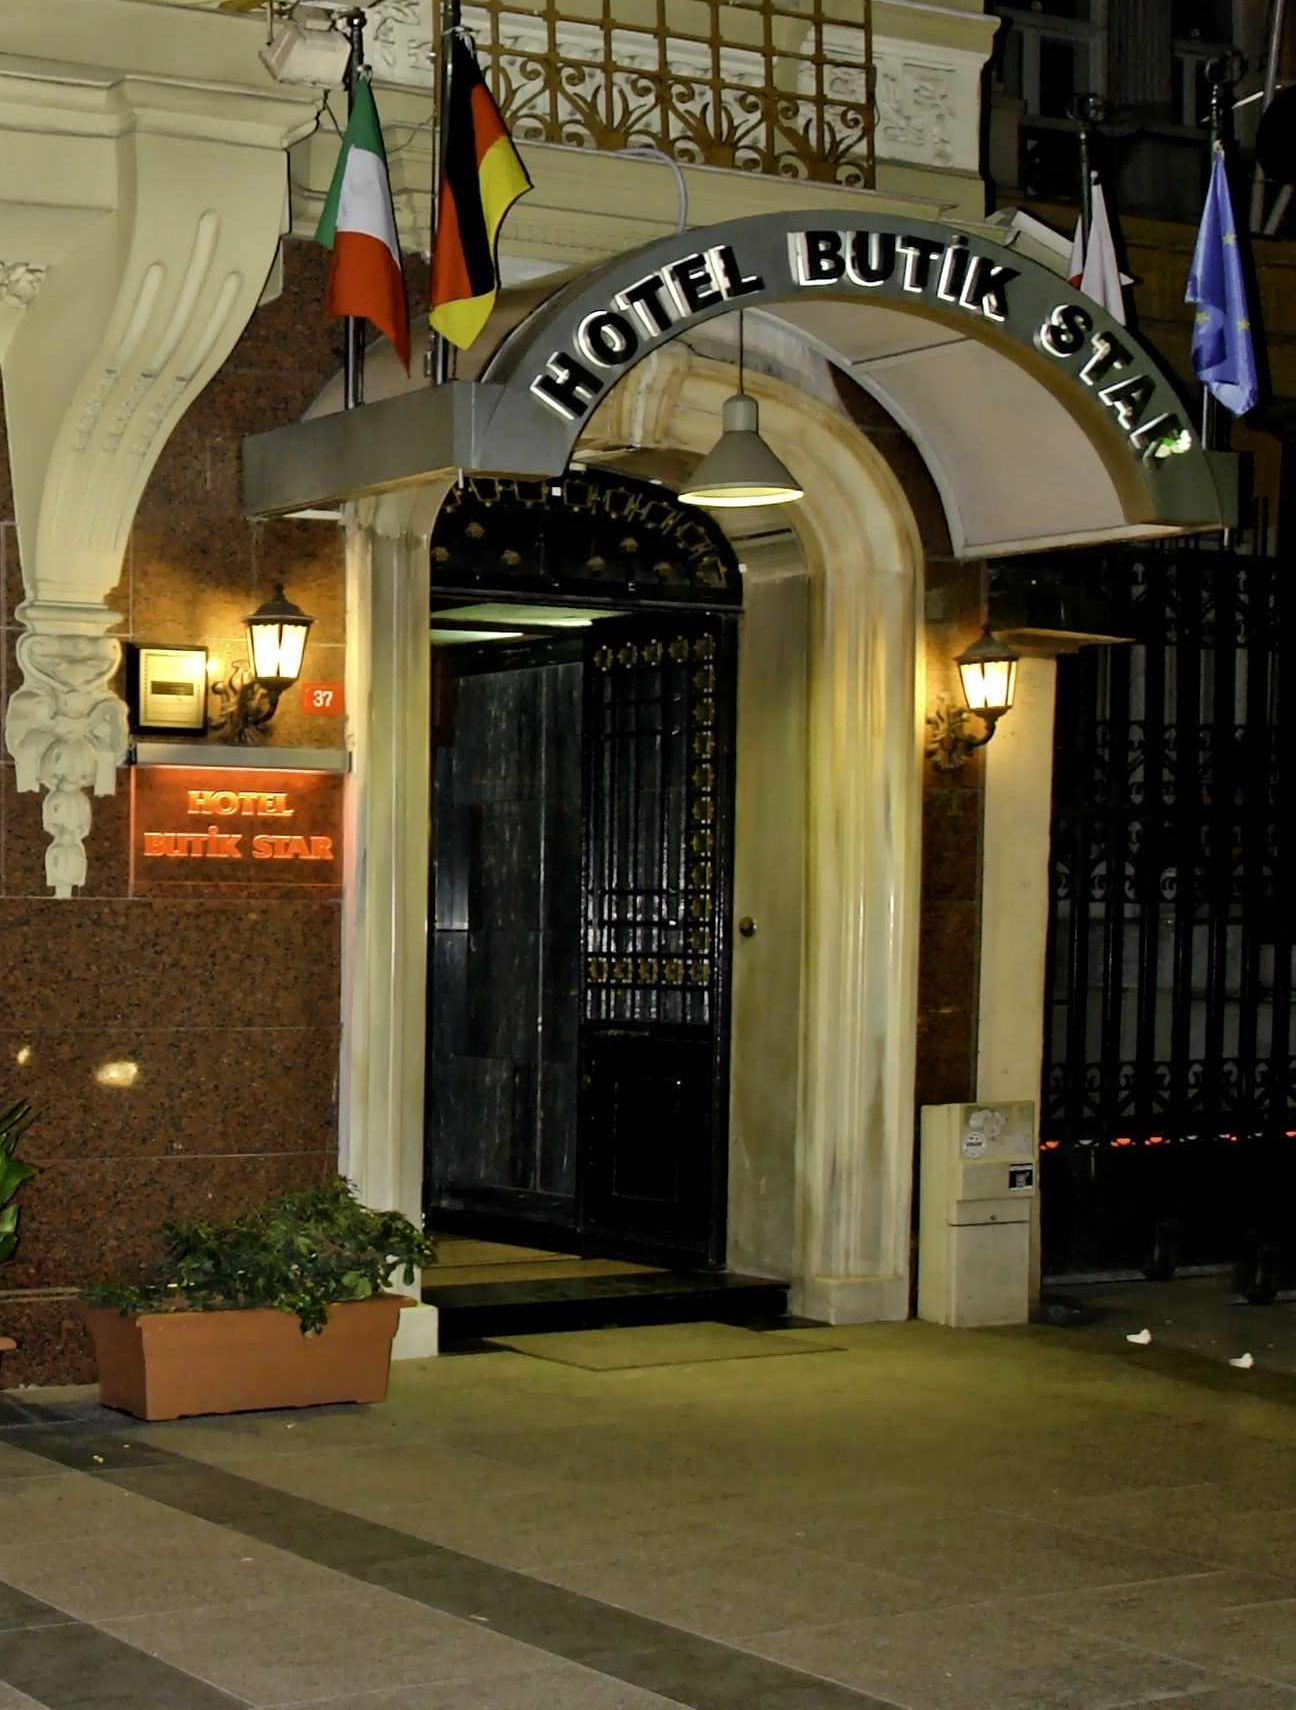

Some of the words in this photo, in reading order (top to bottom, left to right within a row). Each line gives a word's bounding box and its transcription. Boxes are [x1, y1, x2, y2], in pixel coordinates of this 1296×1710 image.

[530, 244, 764, 420] HOTEL
[787, 230, 1020, 322] BUTİK
[313, 690, 334, 707] 37
[187, 790, 295, 817] HOTEL
[143, 825, 243, 859] BUTİK
[252, 834, 334, 860] STAR
